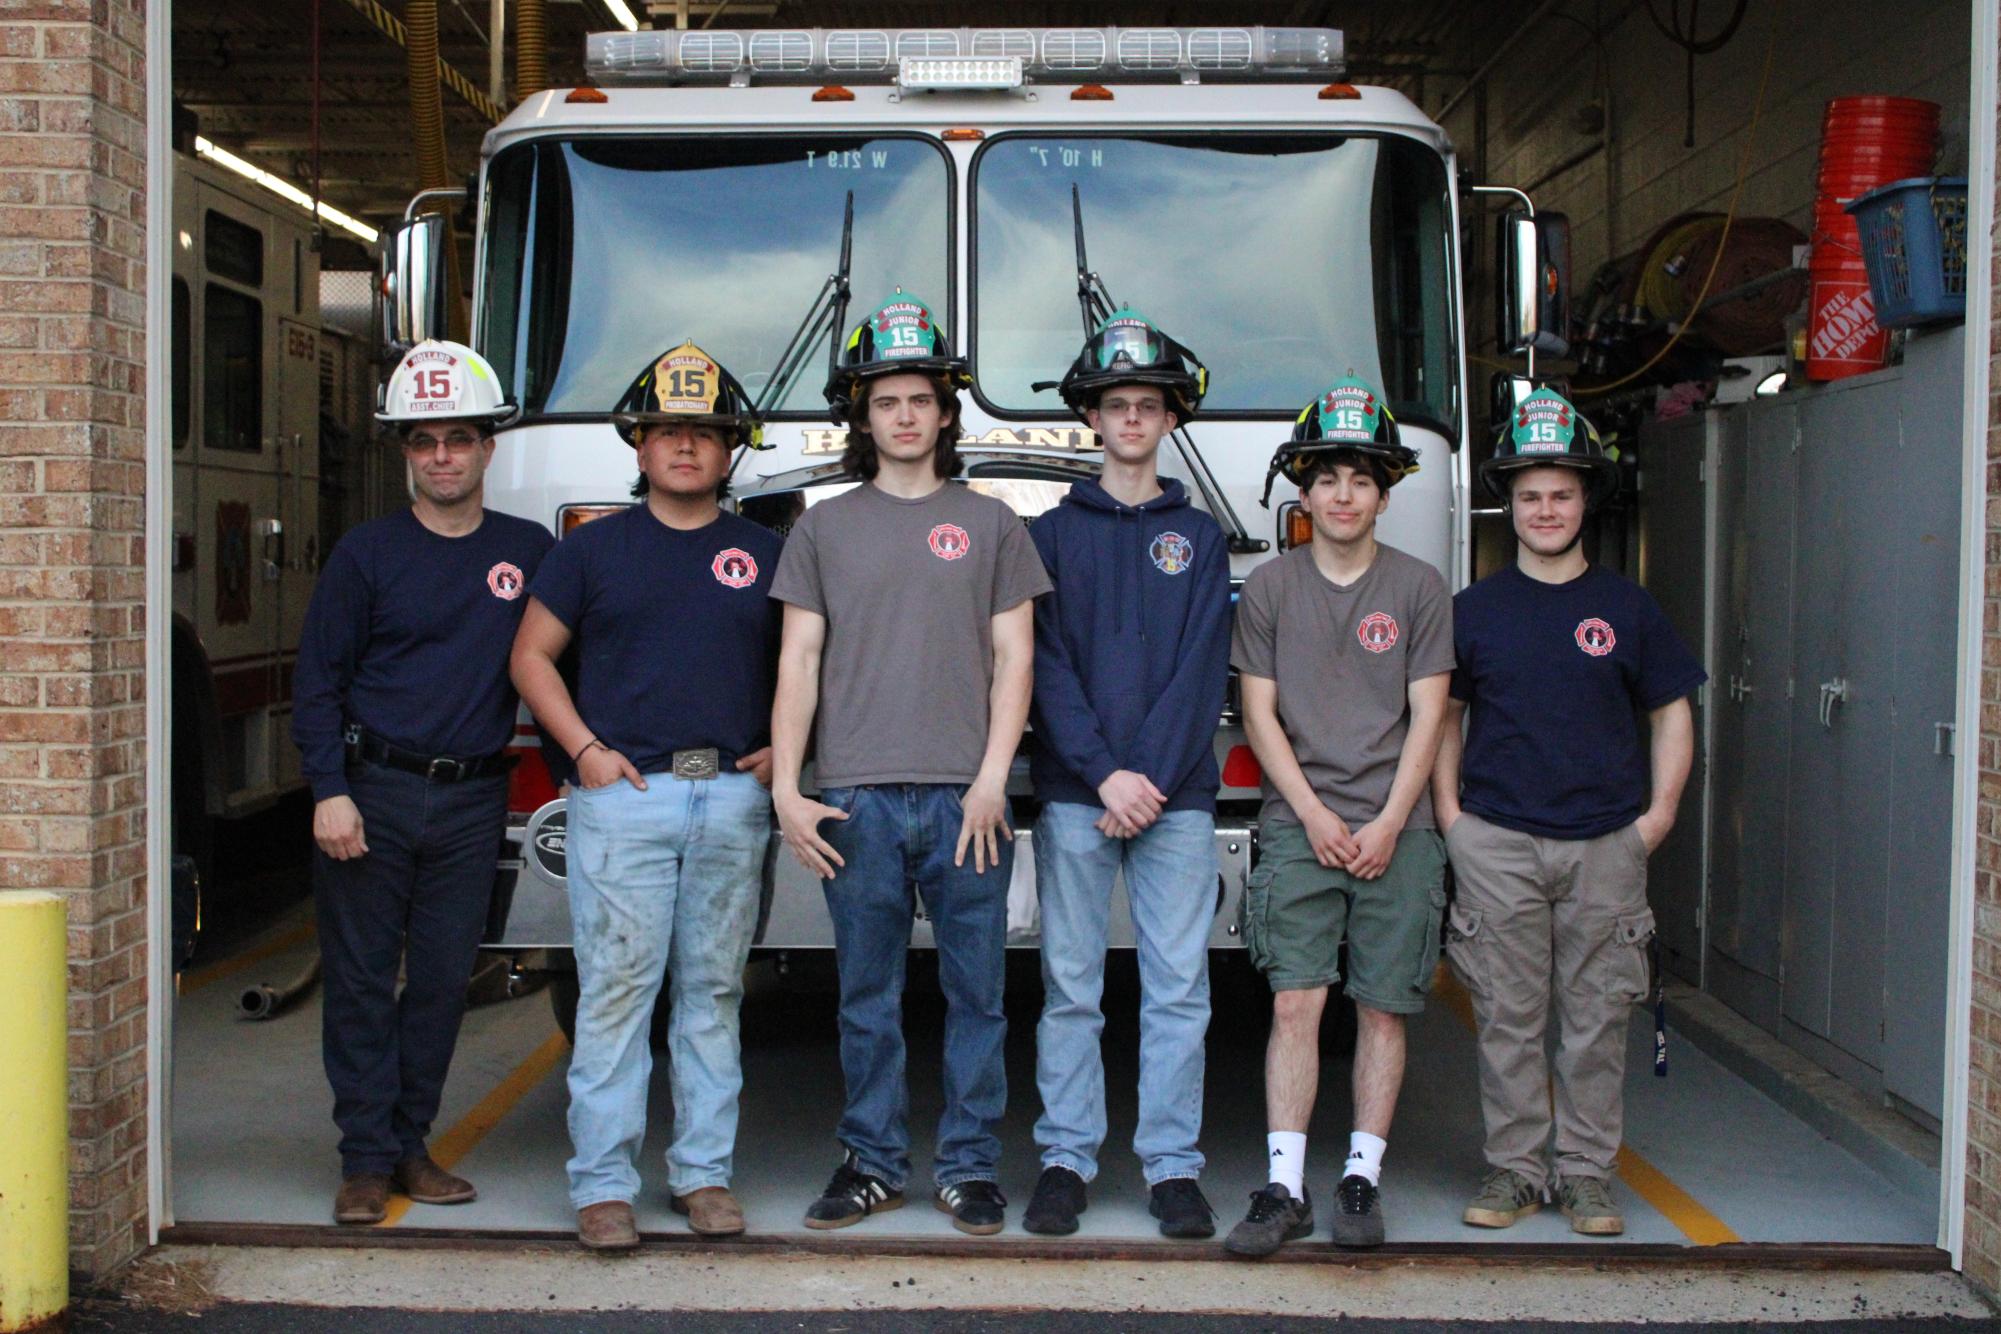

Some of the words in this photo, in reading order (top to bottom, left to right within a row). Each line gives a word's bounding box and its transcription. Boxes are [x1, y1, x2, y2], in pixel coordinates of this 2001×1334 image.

[882, 303, 922, 317] HOLLAND
[1819, 291, 1850, 321] THE
[888, 315, 920, 327] JUNIOR
[1812, 290, 1874, 359] HOM
[891, 326, 919, 347] 15
[1836, 319, 1879, 359] DEPO
[412, 351, 450, 364] HOLLAND
[884, 347, 928, 357] FIREFIGHTER
[670, 356, 708, 369] HOLLAND
[413, 370, 450, 399] 15
[669, 370, 705, 397] 15
[1330, 387, 1369, 399] HOLLAND
[432, 401, 455, 411] CHIEF
[665, 400, 708, 410] PROBATIONARY
[1335, 399, 1365, 410] JUNIOR
[1524, 400, 1564, 412] HOLLAND
[1336, 410, 1362, 430] 15
[1527, 411, 1559, 423] JUNIOR
[1327, 430, 1370, 440] FIREFIGHTER
[1529, 422, 1556, 442] 15
[801, 427, 1105, 455] HLAND
[1521, 443, 1564, 452] FIREFIGHTER
